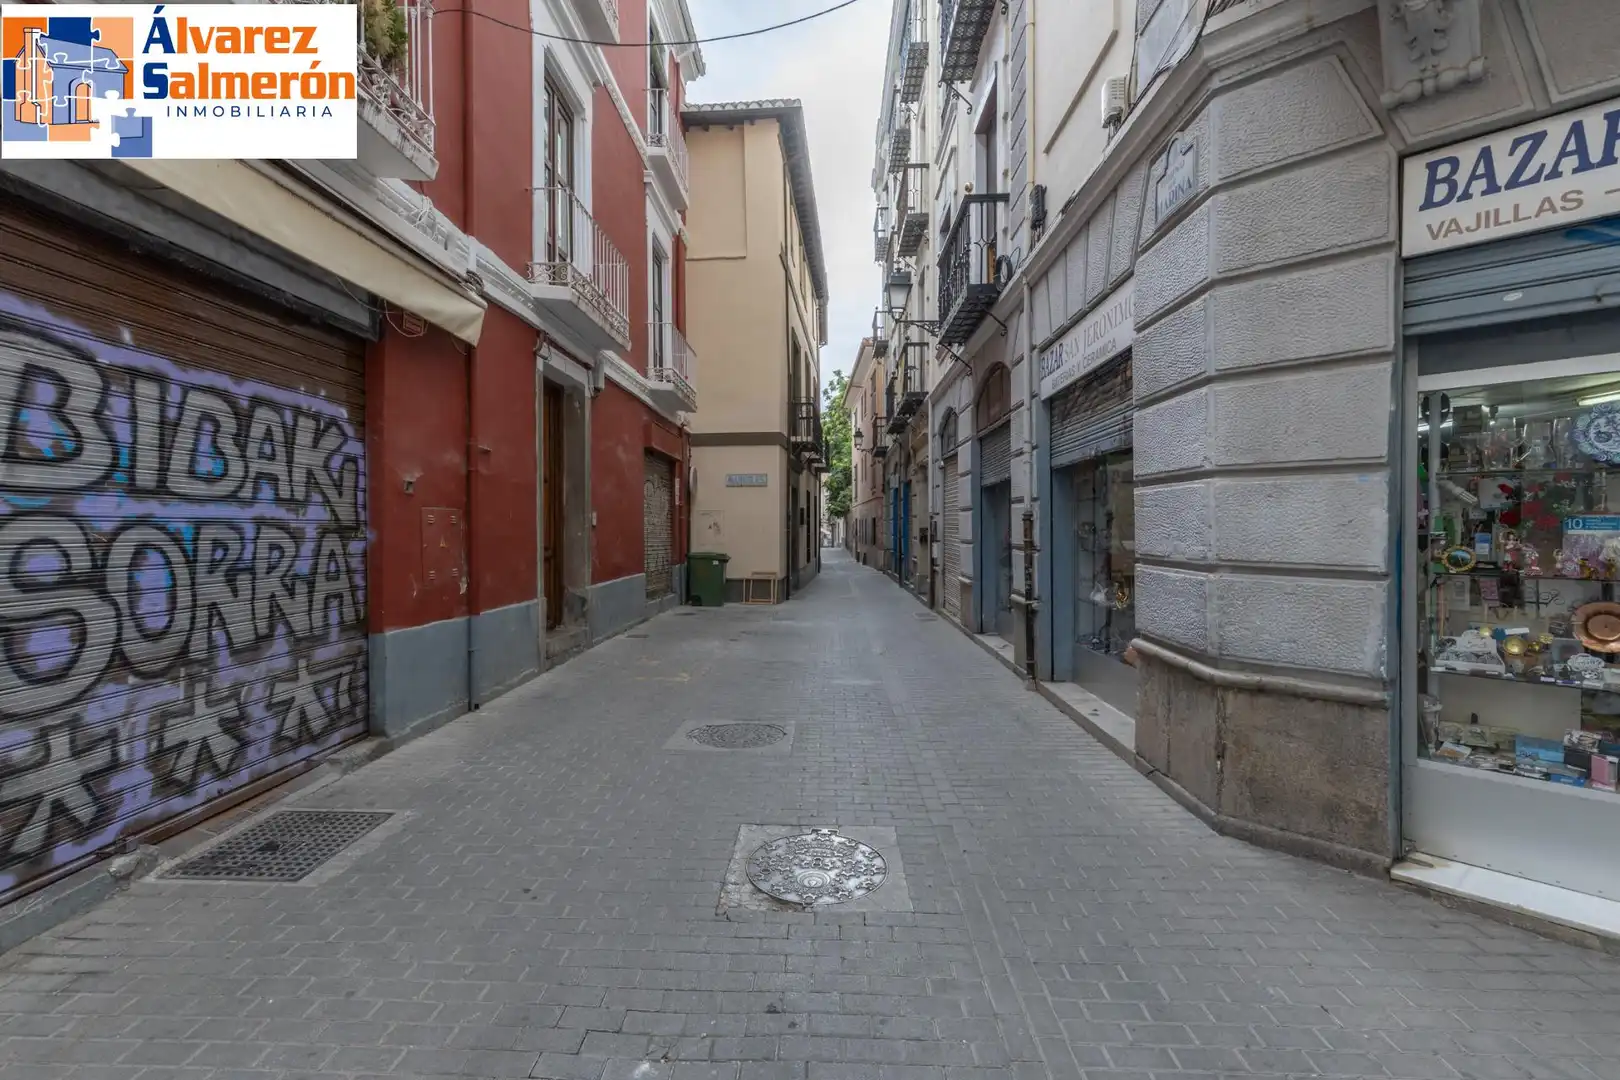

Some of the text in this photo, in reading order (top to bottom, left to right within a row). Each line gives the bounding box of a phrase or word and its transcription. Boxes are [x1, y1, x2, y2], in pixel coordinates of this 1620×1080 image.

[1426, 189, 1584, 241] VAJILLAS
[1040, 342, 1064, 381] BAZAR
[1065, 333, 1080, 362] SAN
[1564, 518, 1584, 530] 10
[0, 511, 365, 720] SORRA
